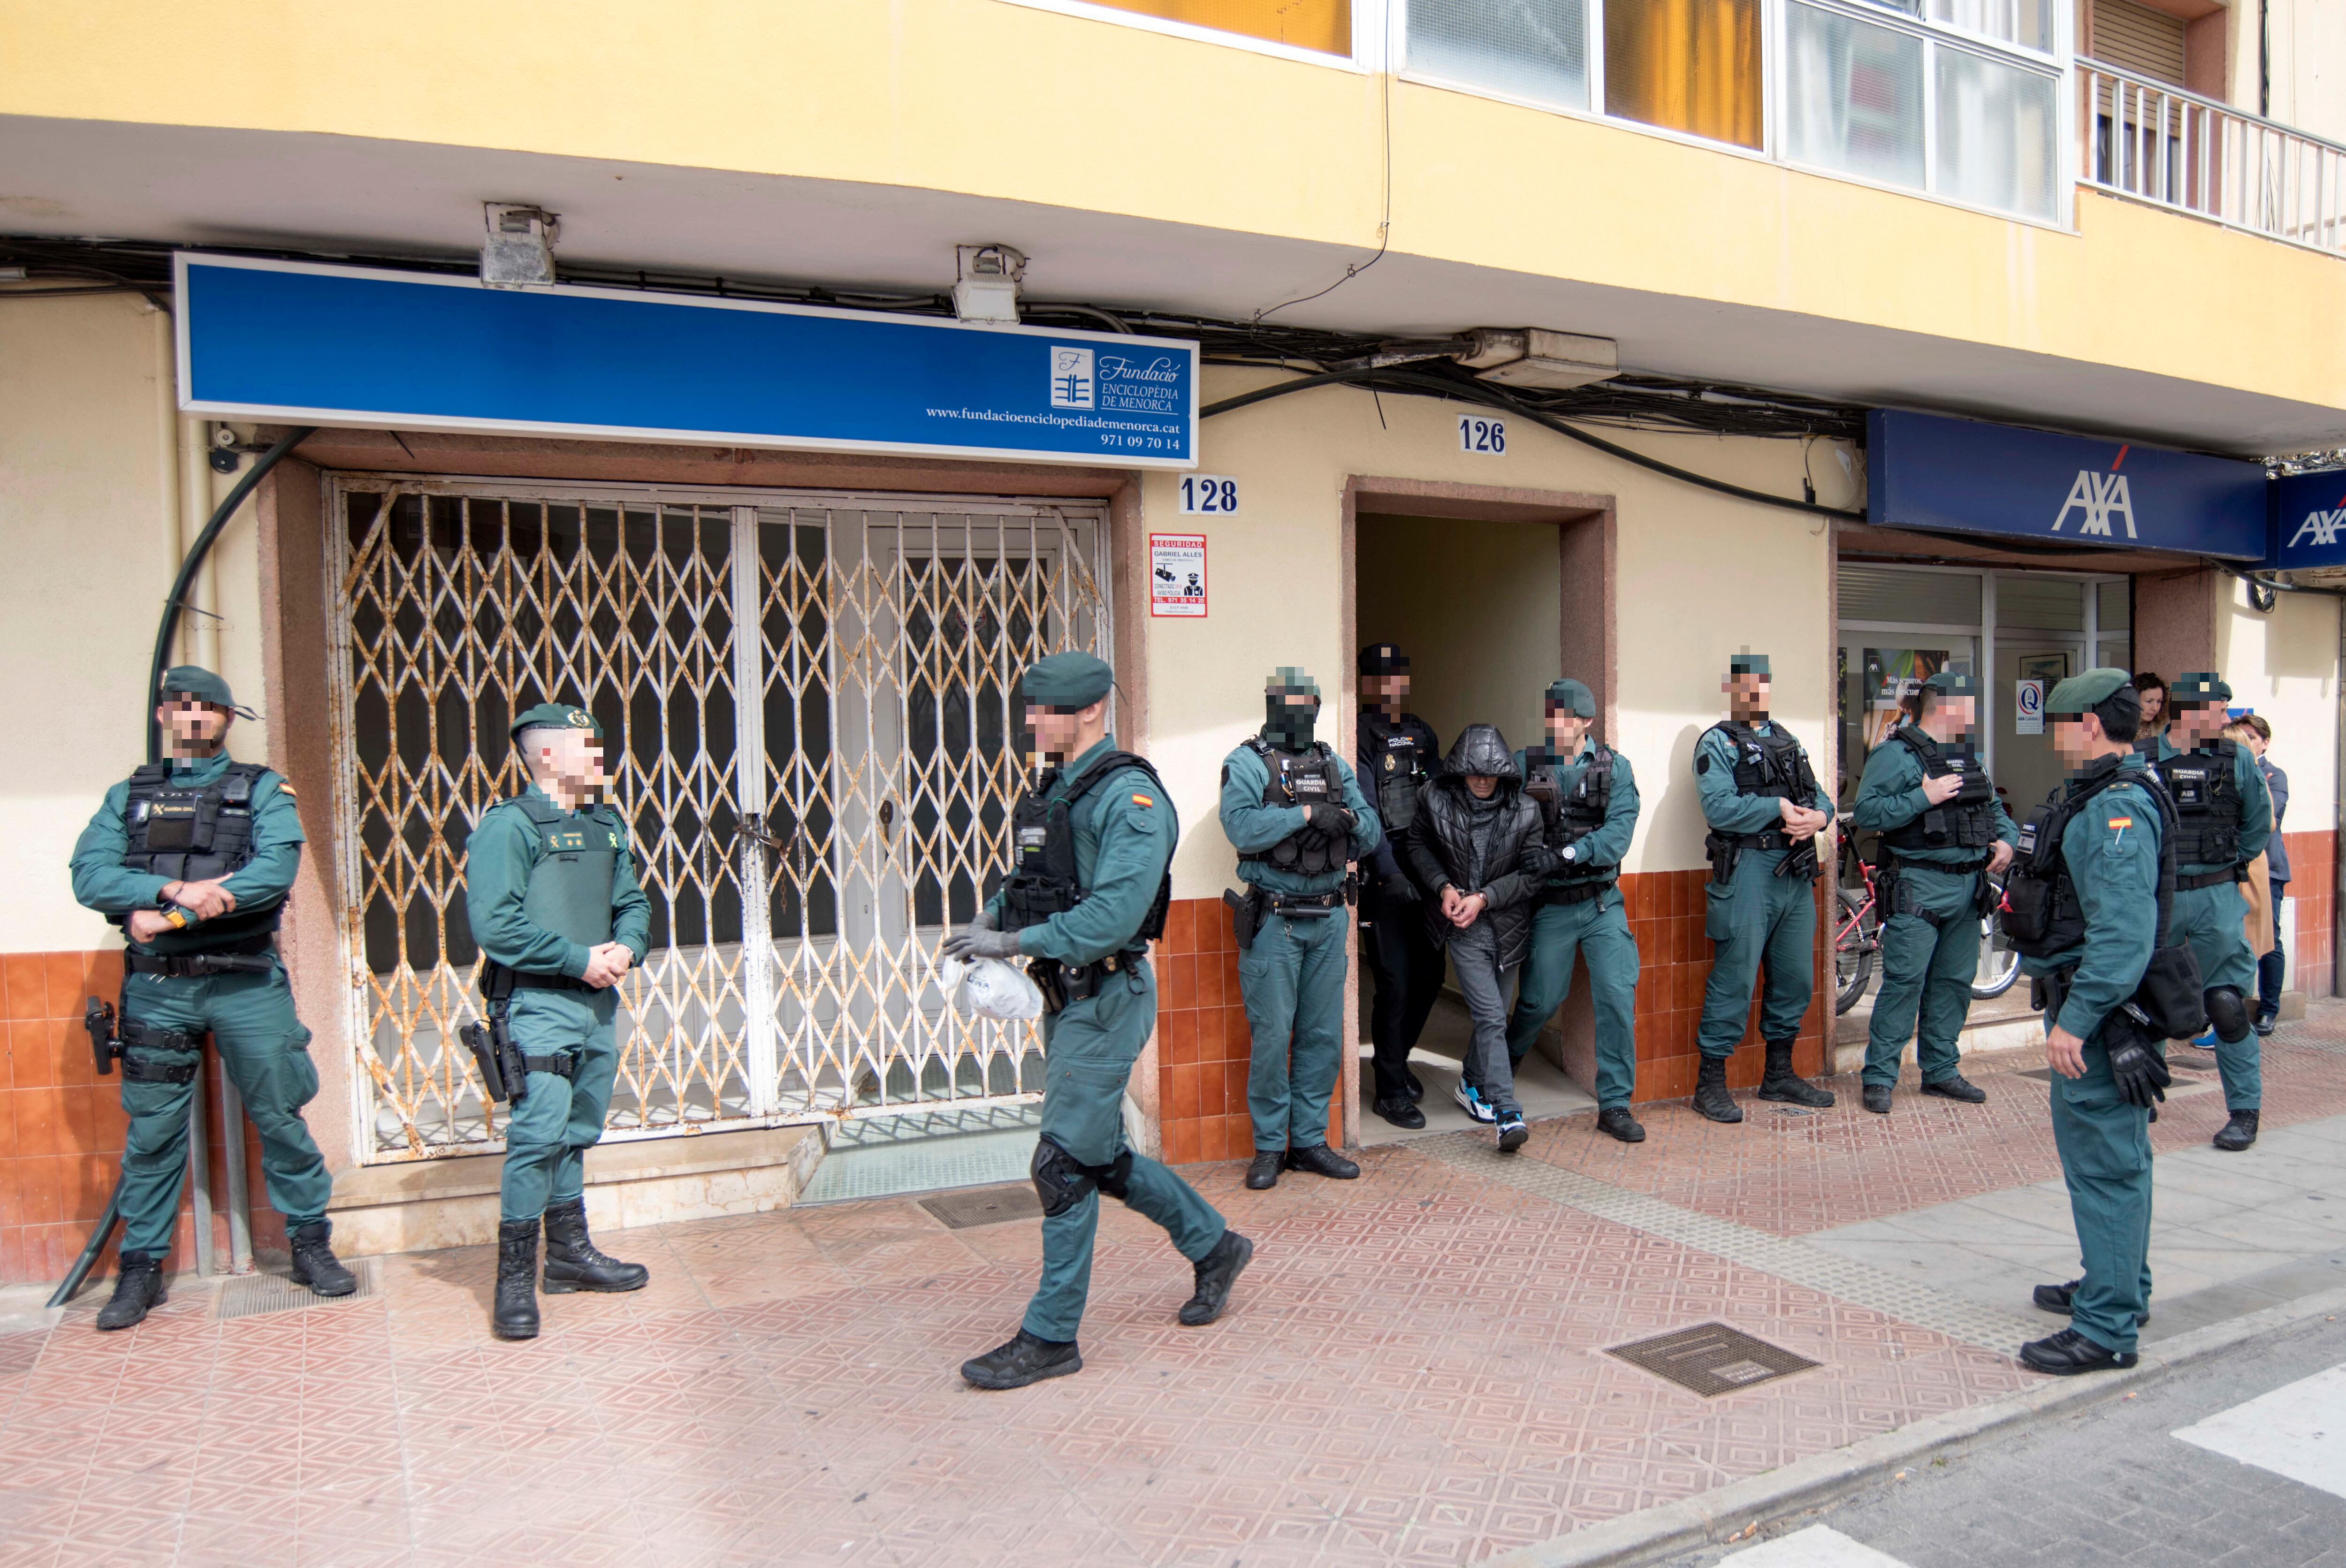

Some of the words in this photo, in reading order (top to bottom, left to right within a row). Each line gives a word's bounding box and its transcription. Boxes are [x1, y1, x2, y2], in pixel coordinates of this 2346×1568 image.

[1099, 356, 1181, 383] Fundació
[1103, 383, 1179, 399] ENCICLOPÈDIA
[1102, 396, 1116, 407] DE
[1119, 397, 1172, 411] MENORCA
[926, 407, 1181, 434] www.fundacioenciclopediademenorca.cat
[1101, 434, 1122, 446] 971
[1127, 436, 1143, 447] 09
[1147, 437, 1162, 449] 70
[1166, 439, 1180, 450] 14
[1460, 419, 1505, 452] 126
[1181, 478, 1237, 512] 128
[2051, 470, 2138, 539] AXA
[1887, 675, 1898, 684] Más
[1881, 687, 1895, 695] más
